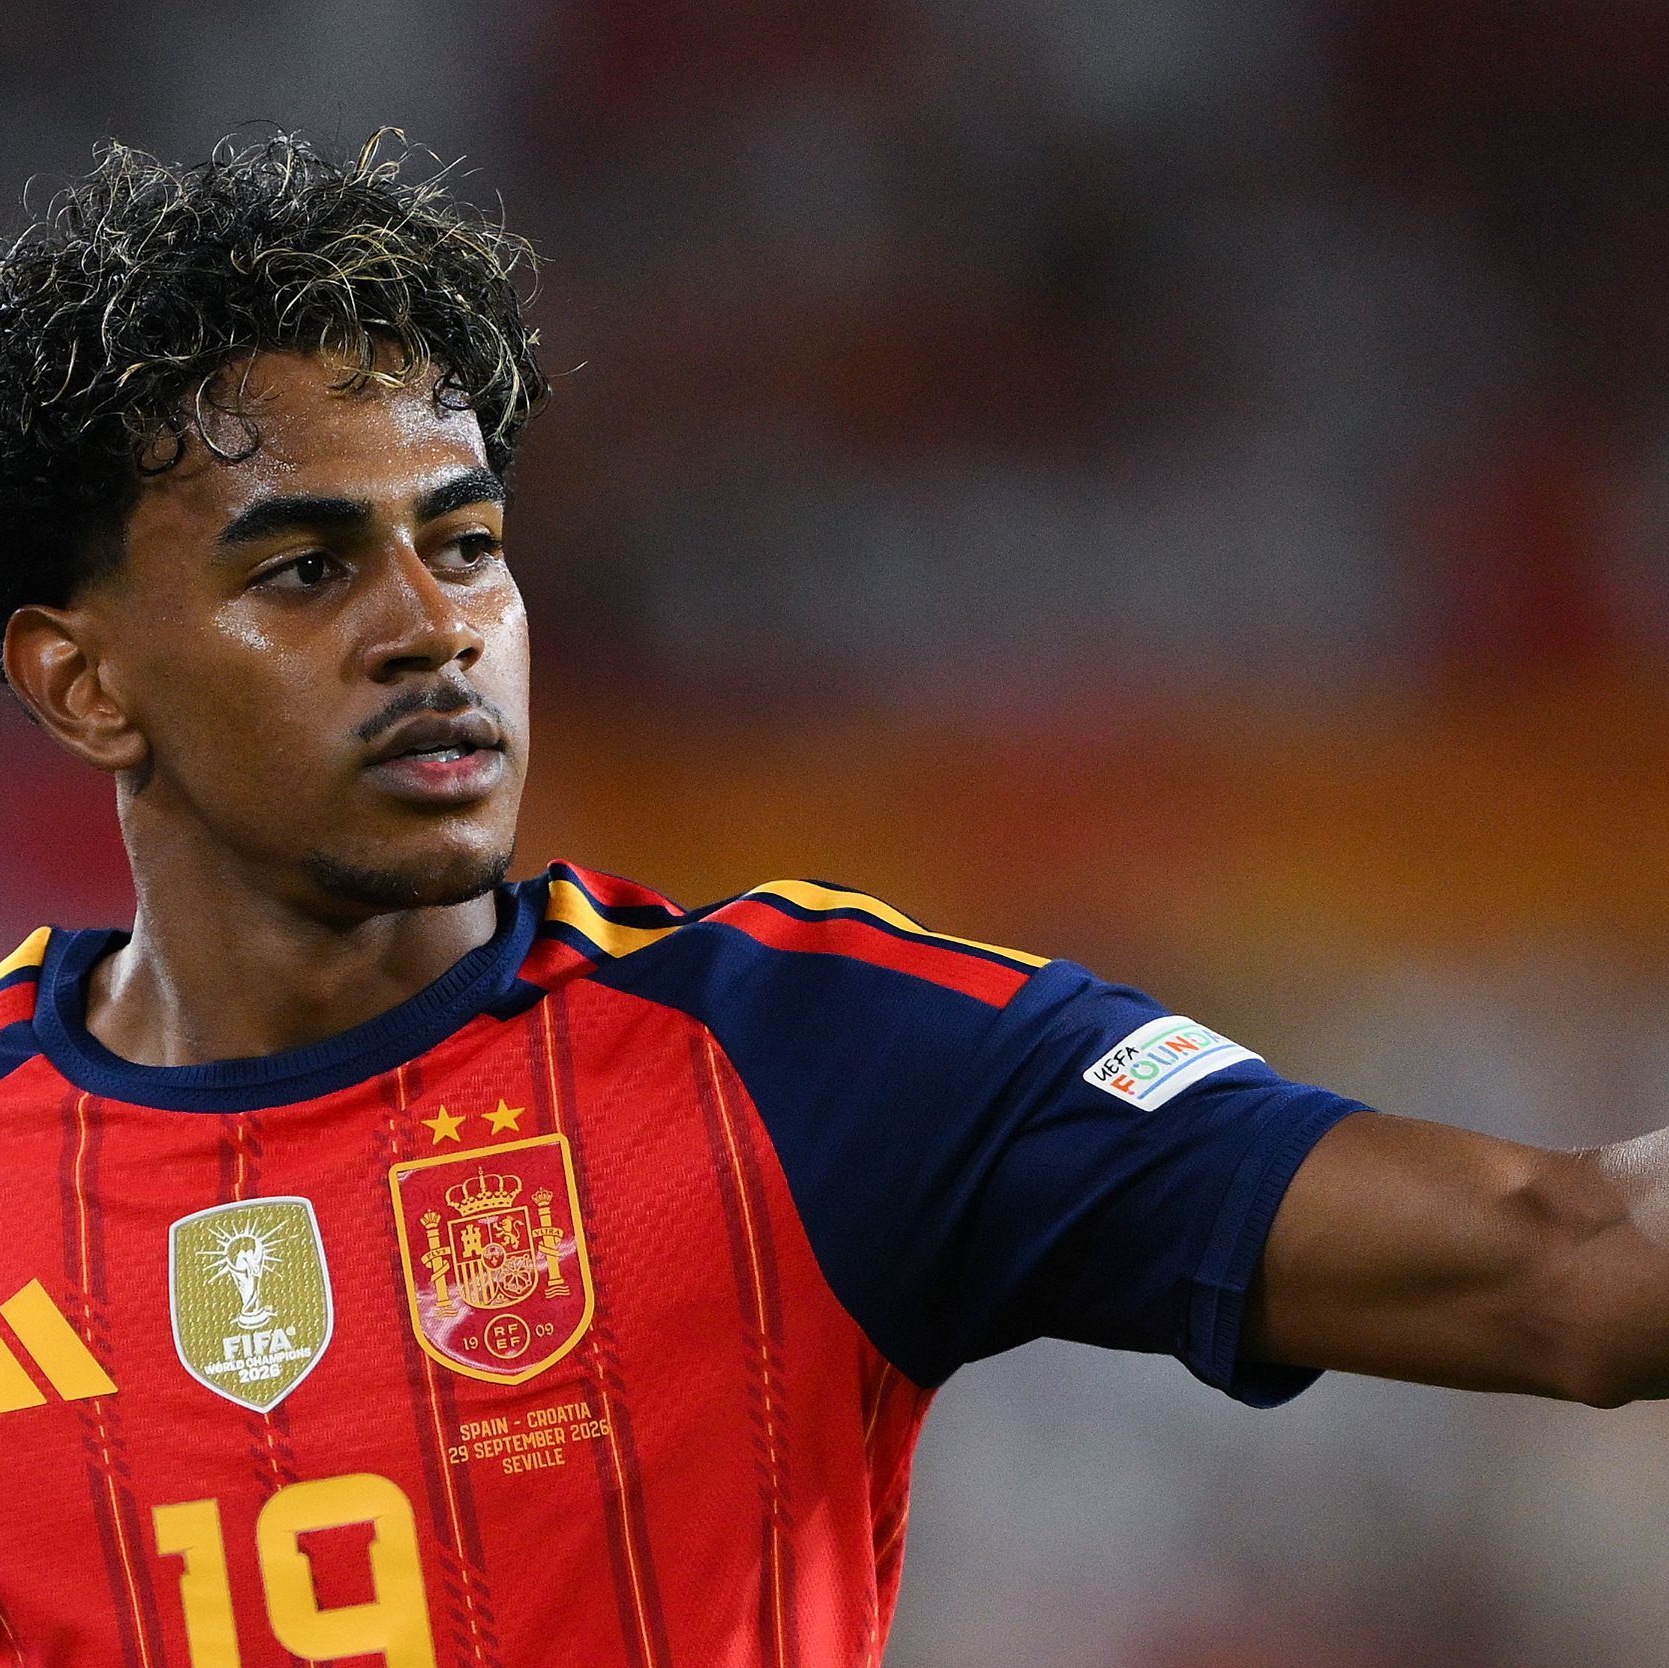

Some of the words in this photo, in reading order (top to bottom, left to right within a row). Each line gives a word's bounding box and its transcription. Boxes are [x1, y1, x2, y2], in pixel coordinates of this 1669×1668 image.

[1094, 1046, 1139, 1082] UEFA
[463, 1336, 478, 1350] 19
[535, 1322, 554, 1337] 09
[223, 1328, 292, 1361] FIFA
[204, 1360, 244, 1375] WORLD
[246, 1347, 311, 1367] CHAMPIONS
[238, 1365, 280, 1383] 2026
[459, 1416, 508, 1441] SPAIN
[526, 1402, 592, 1428] CROATIA
[448, 1445, 469, 1464] 29
[473, 1427, 566, 1459] SEPTEMBER
[569, 1419, 611, 1441] 2026
[502, 1448, 566, 1474] SEVILLE
